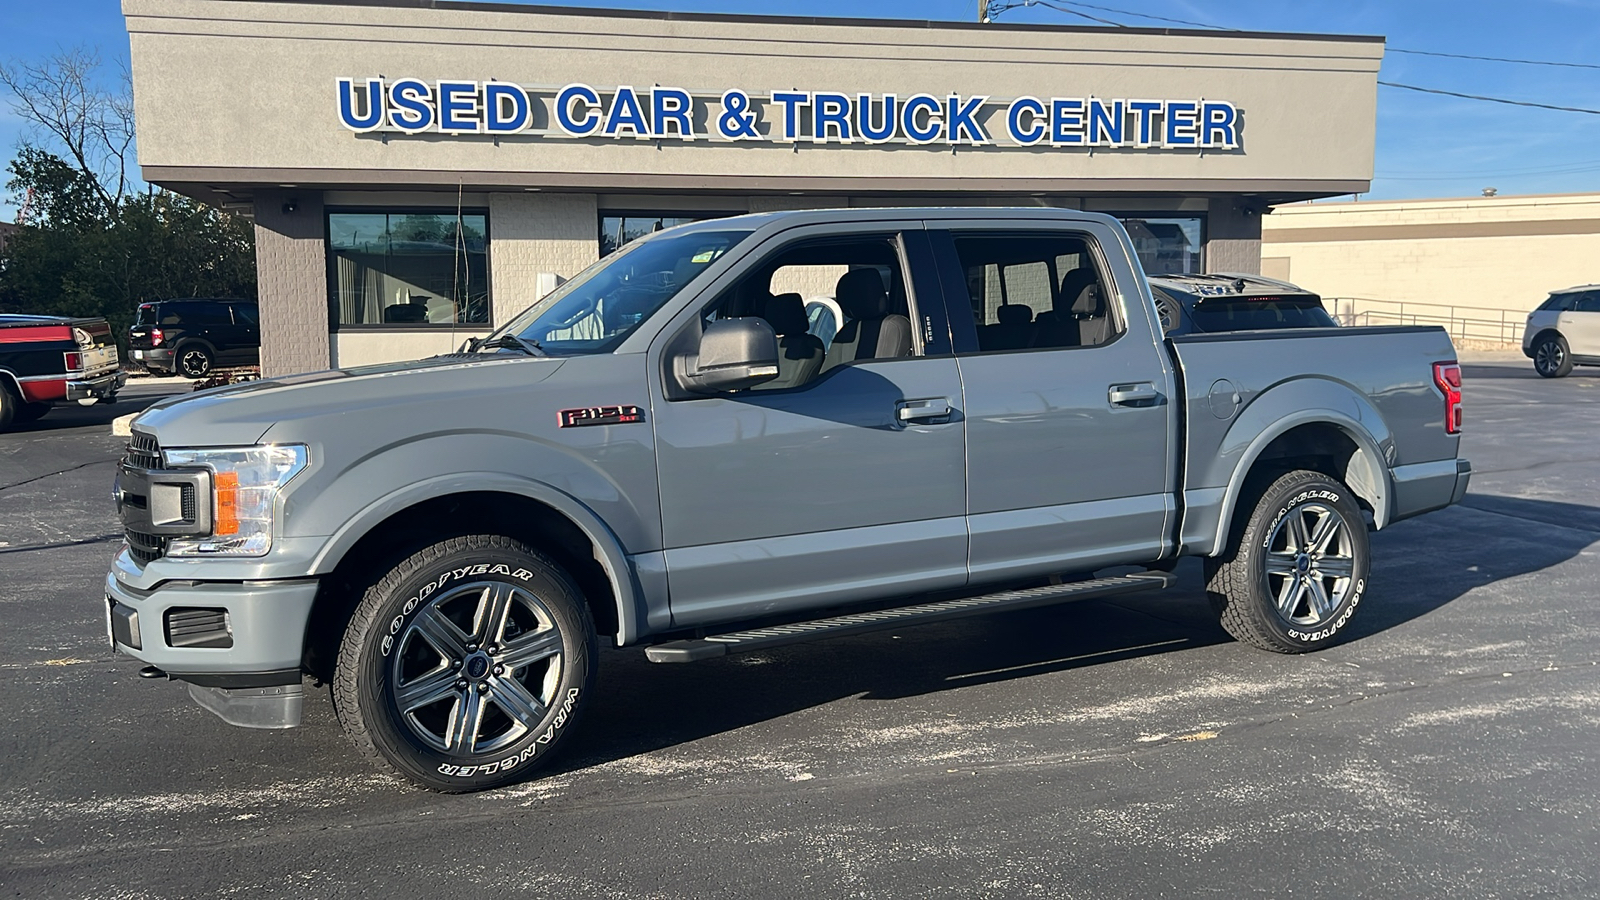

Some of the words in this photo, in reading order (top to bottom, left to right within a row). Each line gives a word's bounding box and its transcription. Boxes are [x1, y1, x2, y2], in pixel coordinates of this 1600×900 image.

[335, 77, 531, 135] USED
[555, 83, 696, 140] CAR
[715, 88, 764, 141] &
[770, 89, 990, 145] TRUCK
[1005, 96, 1239, 149] CENTER
[1263, 490, 1339, 548] WRANGLER
[381, 563, 534, 656] GOODYEAR
[1288, 578, 1364, 641] GOODYEAR
[437, 688, 579, 776] WRANGLER
